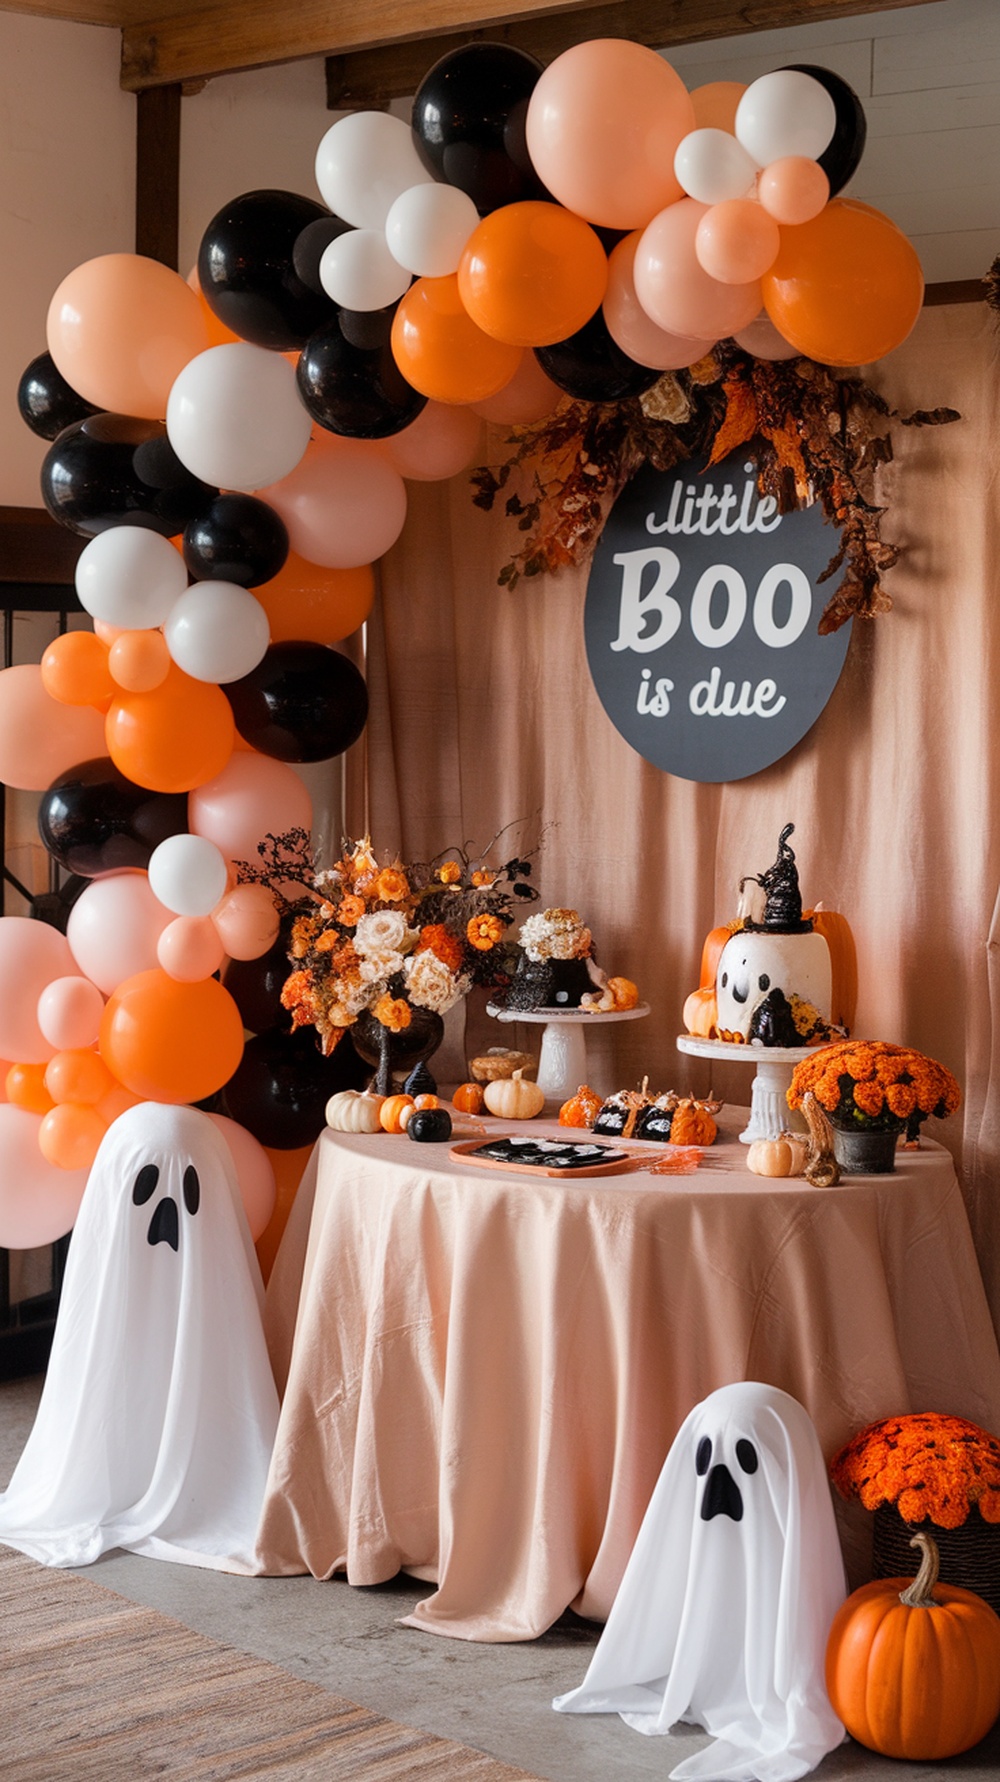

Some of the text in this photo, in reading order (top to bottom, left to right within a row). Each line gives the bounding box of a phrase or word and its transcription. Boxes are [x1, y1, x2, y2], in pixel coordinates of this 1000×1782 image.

[646, 462, 783, 535] little
[637, 666, 787, 718] is due
